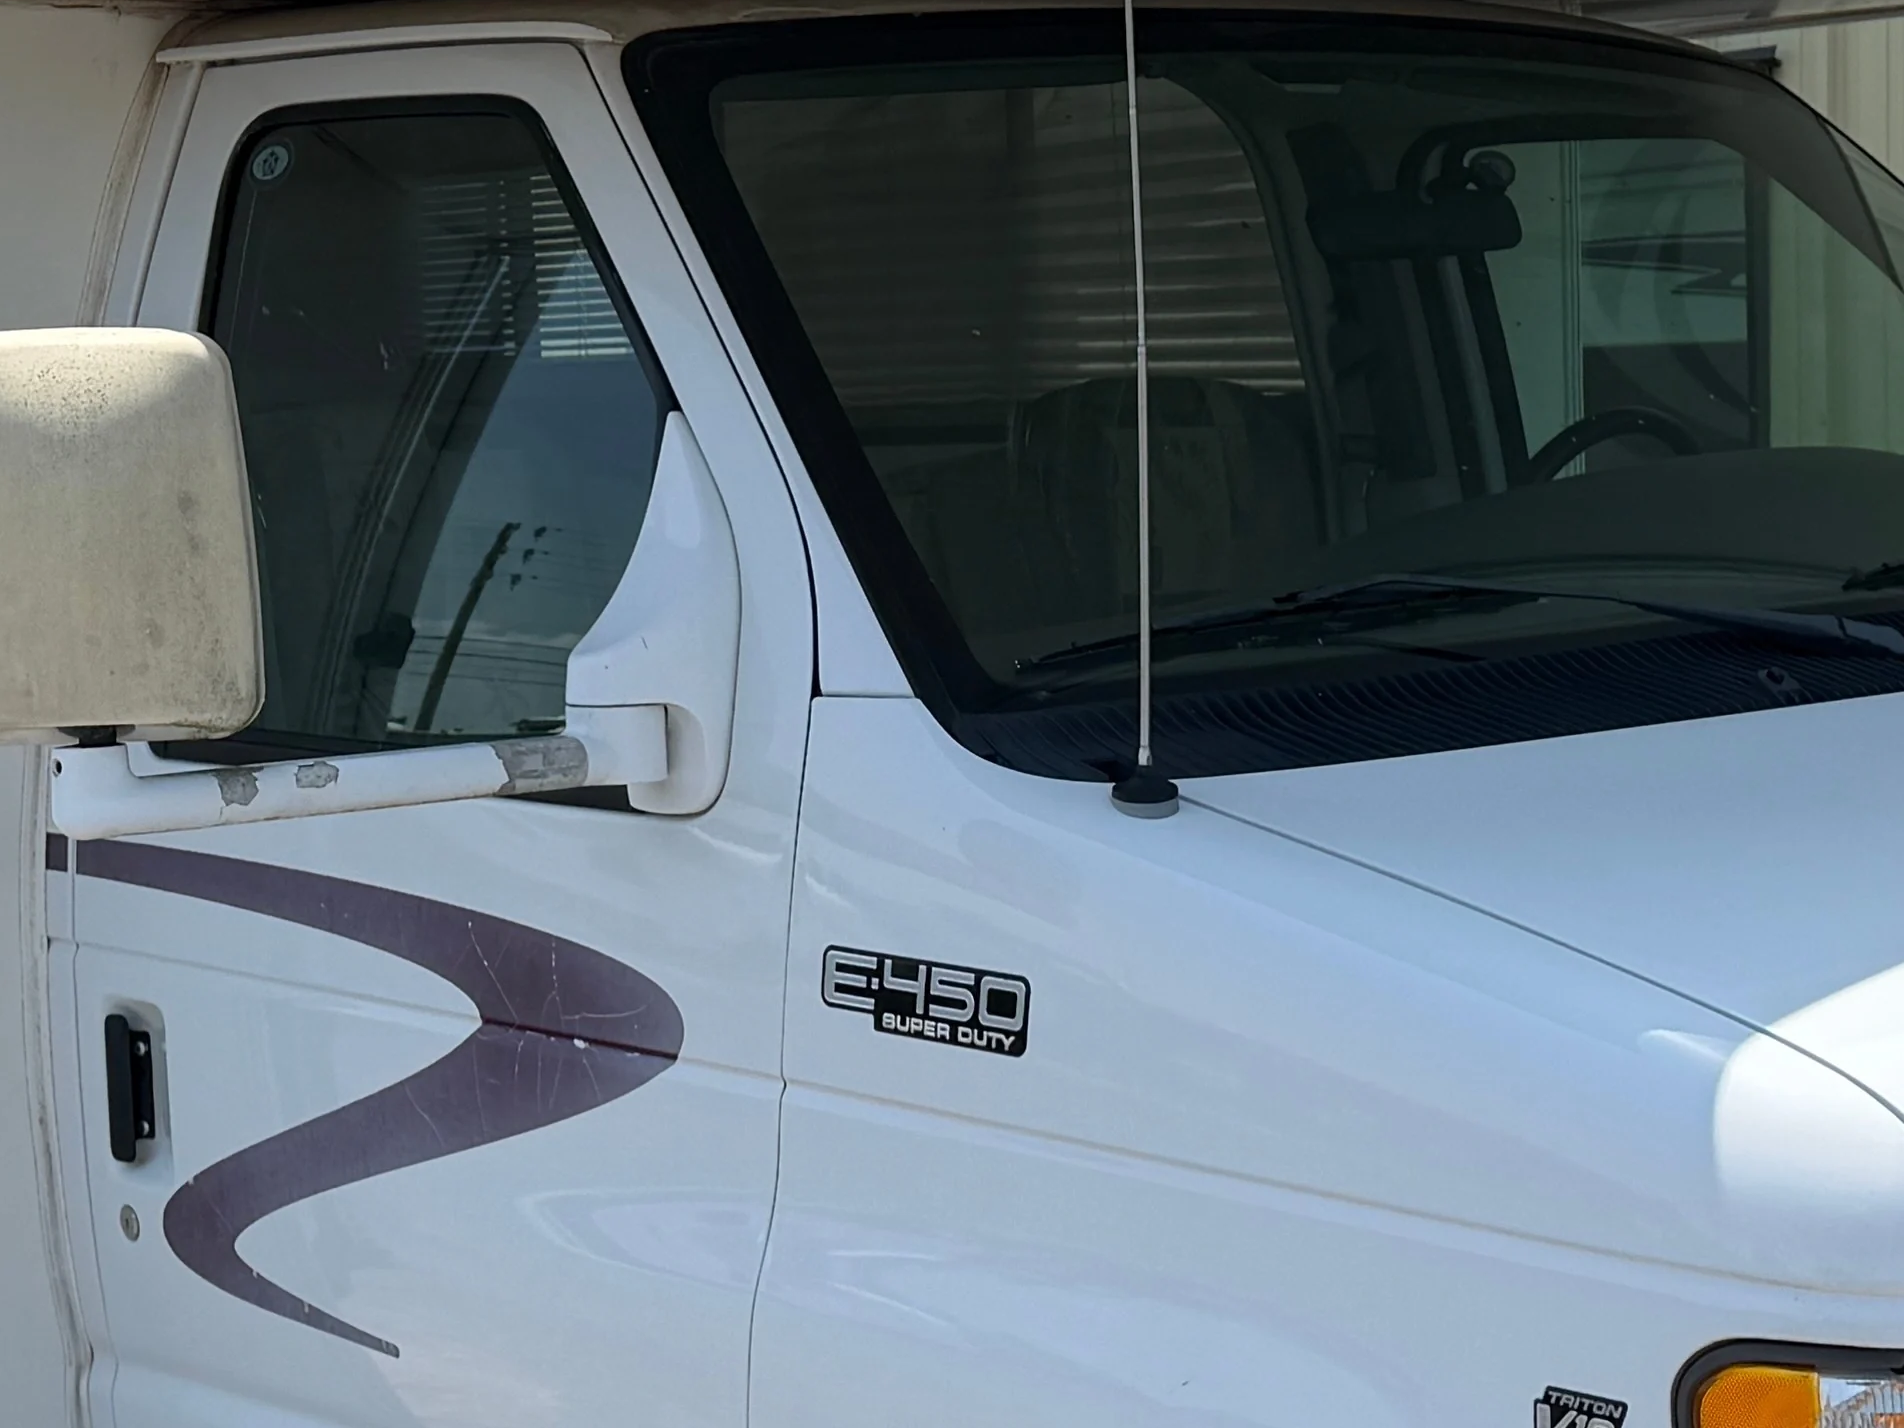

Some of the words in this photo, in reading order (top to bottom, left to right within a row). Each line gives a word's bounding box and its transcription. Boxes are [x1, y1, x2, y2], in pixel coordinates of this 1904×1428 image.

[881, 1012, 950, 1041] SUPER
[956, 1026, 1016, 1052] DUTY
[1547, 1390, 1623, 1419] TRITON
